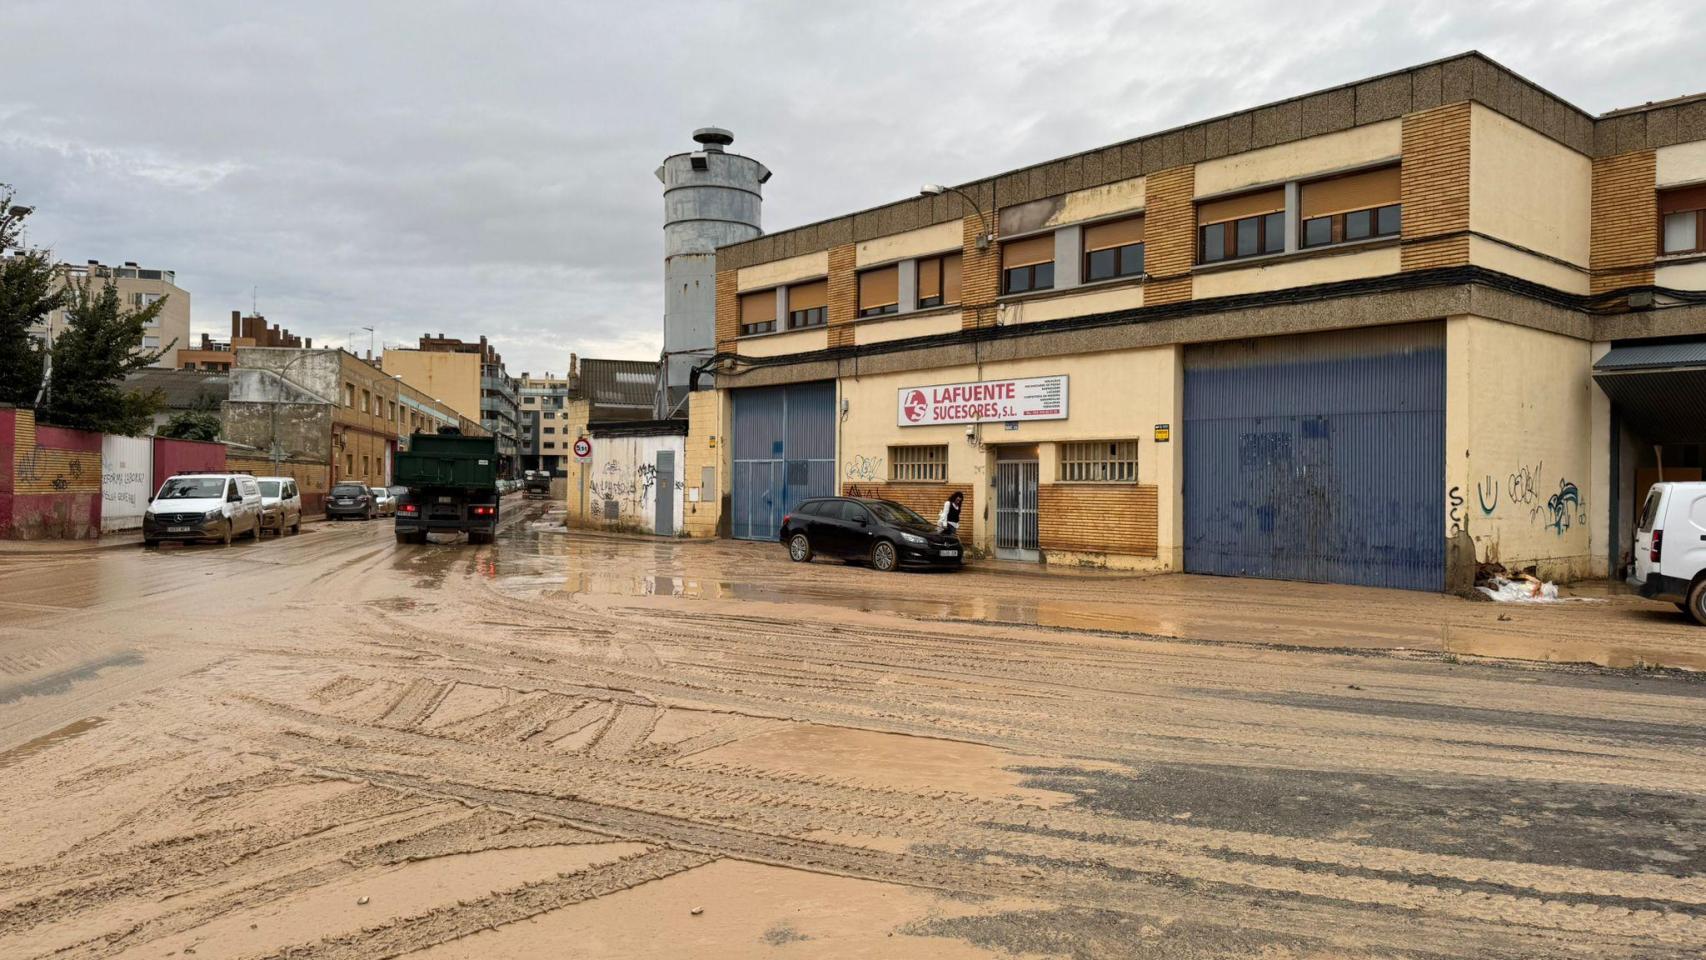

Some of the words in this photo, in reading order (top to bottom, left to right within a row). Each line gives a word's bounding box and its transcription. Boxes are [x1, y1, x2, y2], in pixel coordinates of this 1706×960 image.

[933, 383, 1015, 404] LAFUENTE
[933, 402, 1001, 420] SUCESORES,
[1002, 405, 1018, 417] S.L.
